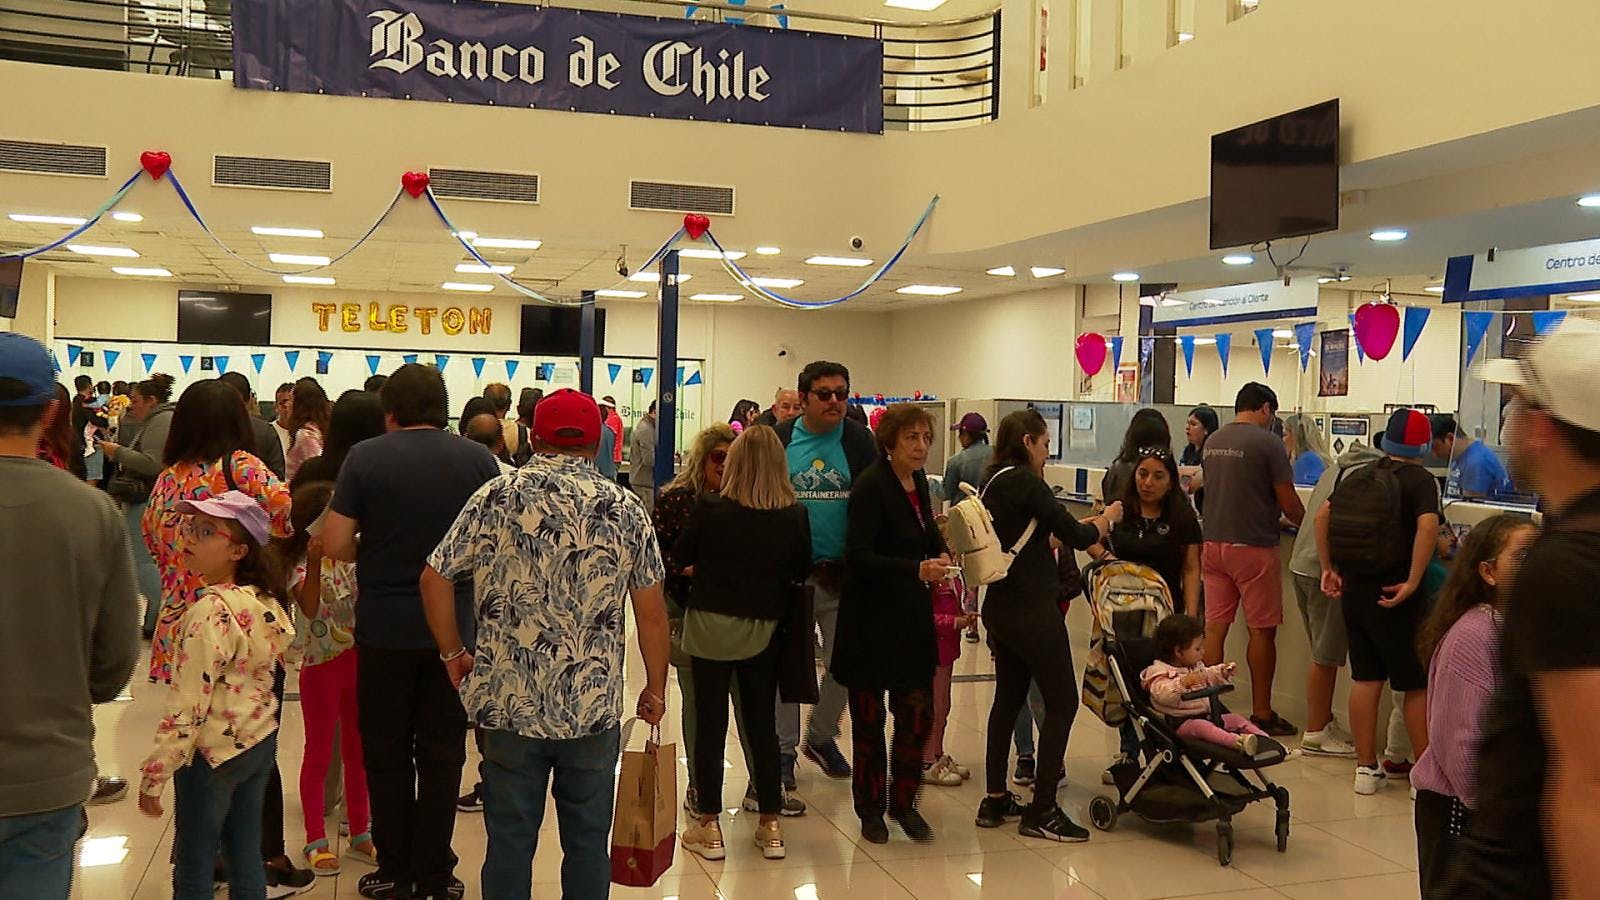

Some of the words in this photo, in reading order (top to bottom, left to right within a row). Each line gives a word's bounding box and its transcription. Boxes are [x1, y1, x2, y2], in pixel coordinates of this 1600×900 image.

[367, 10, 546, 86] Banco
[568, 35, 620, 90] de
[642, 39, 770, 105] Chile
[1545, 256, 1585, 270] Centro
[312, 301, 492, 336] TELETON
